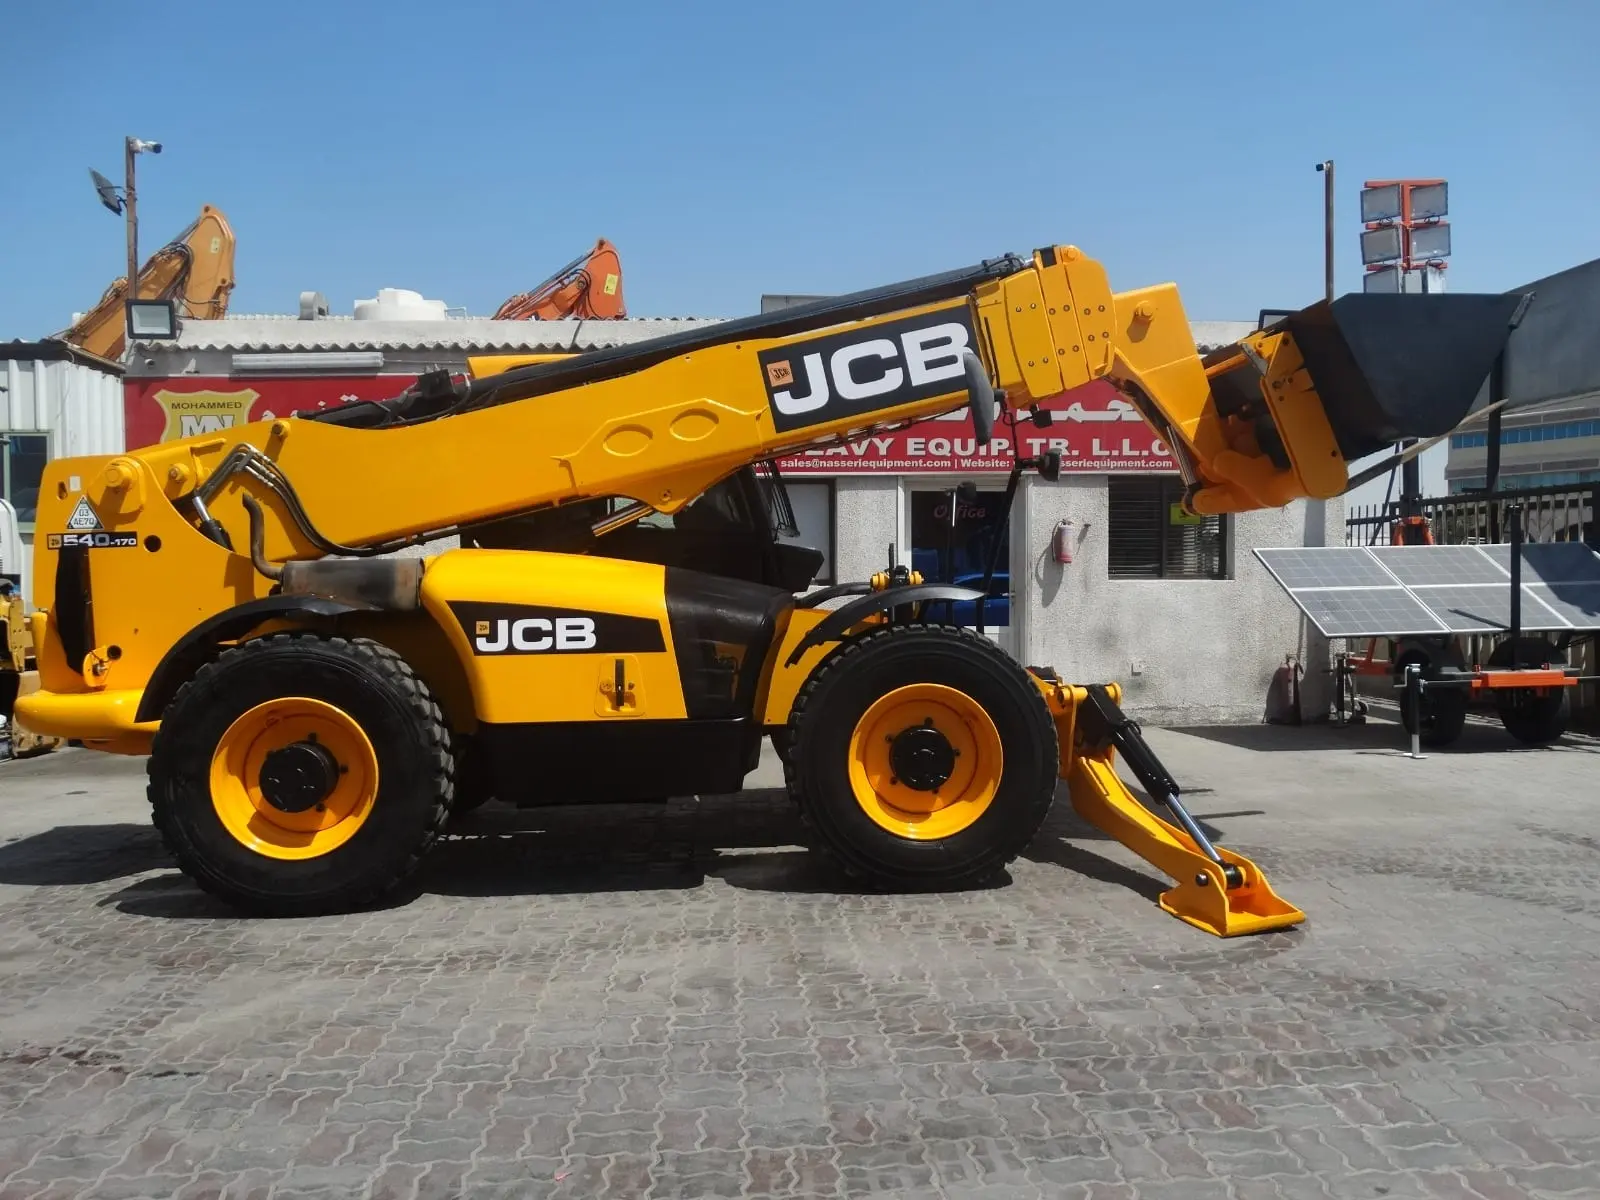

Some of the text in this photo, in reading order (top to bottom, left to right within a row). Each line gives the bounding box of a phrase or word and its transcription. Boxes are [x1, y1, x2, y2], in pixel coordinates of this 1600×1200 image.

[773, 322, 973, 415] JCB
[171, 401, 242, 410] MOHAMMED
[906, 437, 1015, 457] EQUIP.
[780, 458, 951, 469] sales@nasseriequipment.com
[960, 458, 1010, 468] Website:
[933, 504, 986, 520] Ofice
[476, 617, 597, 652] JCB
